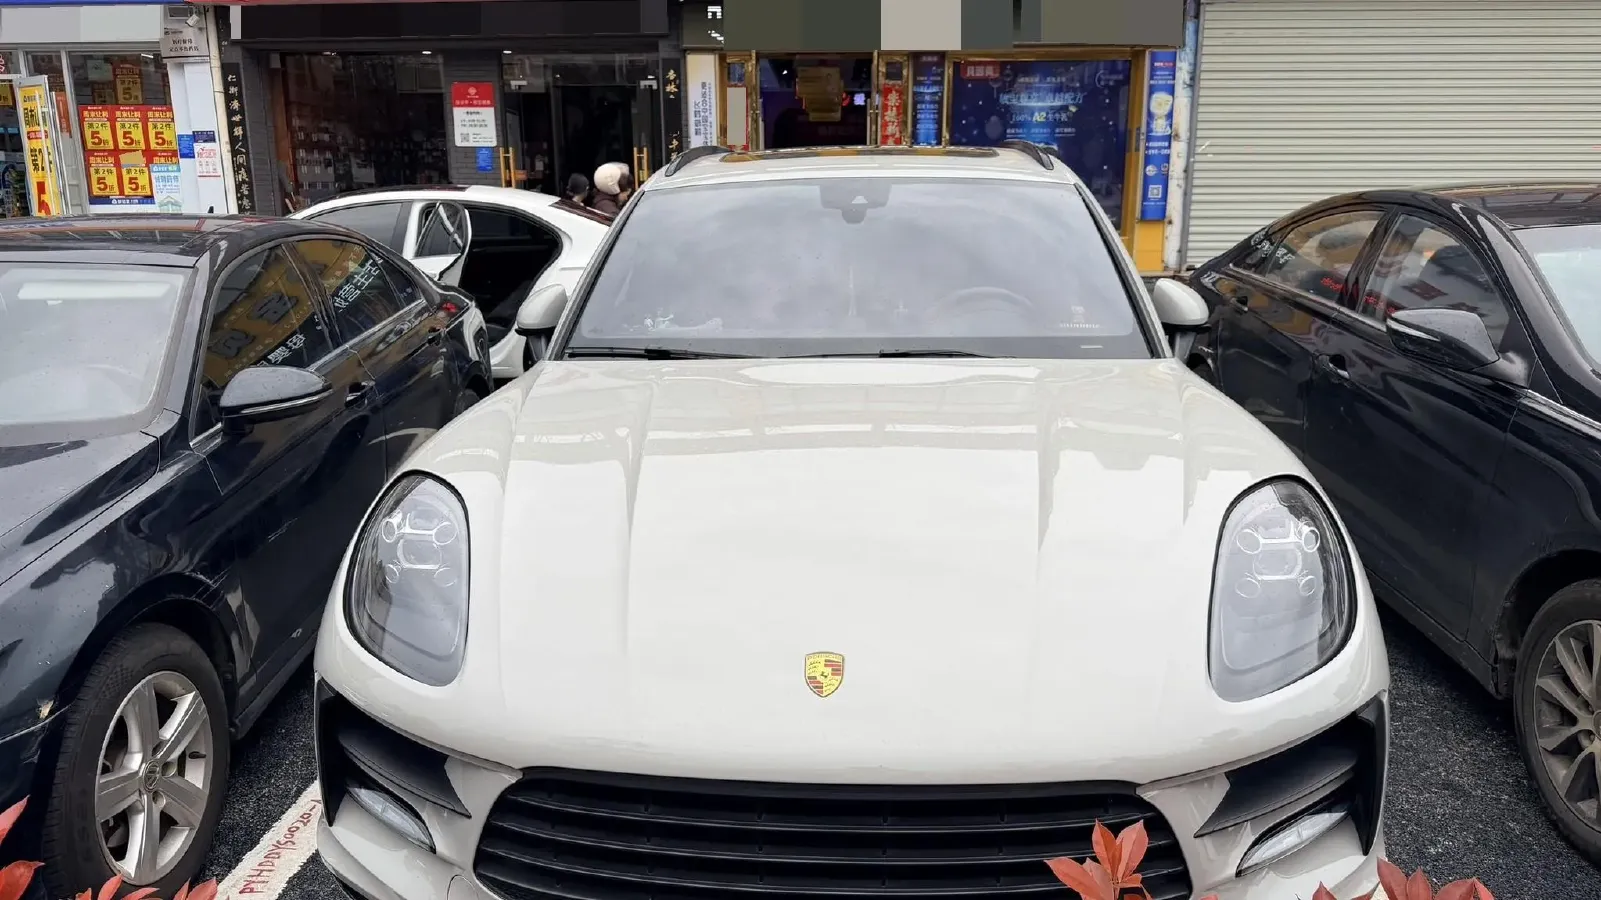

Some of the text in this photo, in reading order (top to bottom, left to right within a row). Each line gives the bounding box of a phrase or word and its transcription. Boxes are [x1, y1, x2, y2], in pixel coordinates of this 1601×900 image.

[1033, 111, 1046, 122] A2
[87, 122, 108, 130] 第2件
[120, 122, 141, 130] 第2件
[152, 122, 172, 130] 第2件
[90, 131, 109, 147] 5折
[123, 131, 141, 147] 5折
[155, 131, 173, 147] 5折
[96, 177, 115, 192] 5折
[128, 177, 147, 192] 5折
